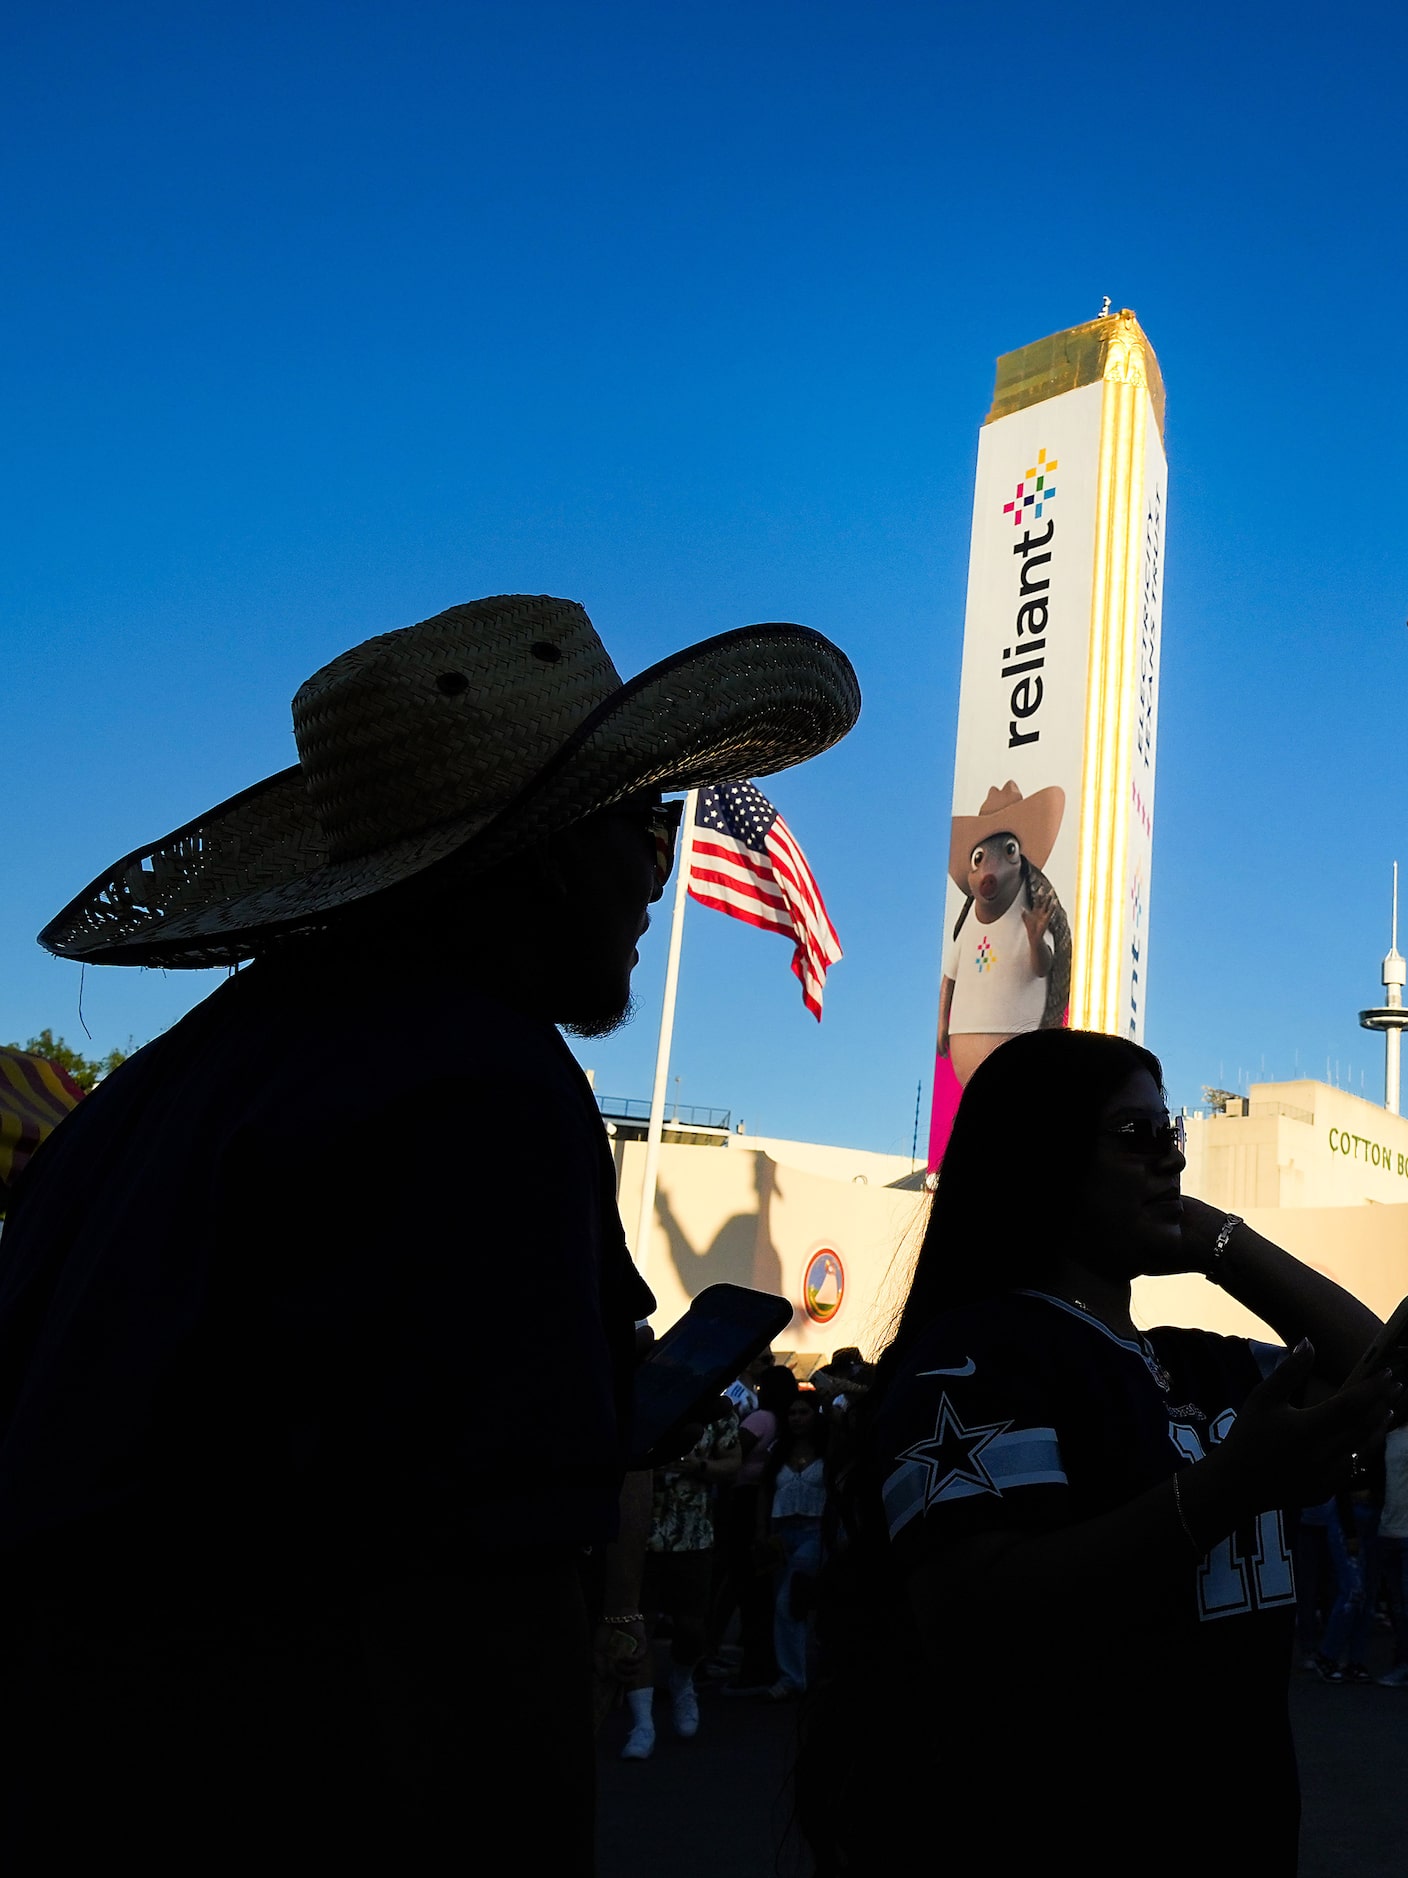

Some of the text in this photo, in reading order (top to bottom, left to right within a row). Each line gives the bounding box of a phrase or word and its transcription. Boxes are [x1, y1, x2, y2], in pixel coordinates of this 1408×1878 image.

[1002, 519, 1054, 748] reliant
[1137, 501, 1153, 756] ELECTRICITY
[1329, 1127, 1392, 1171] COTTON
